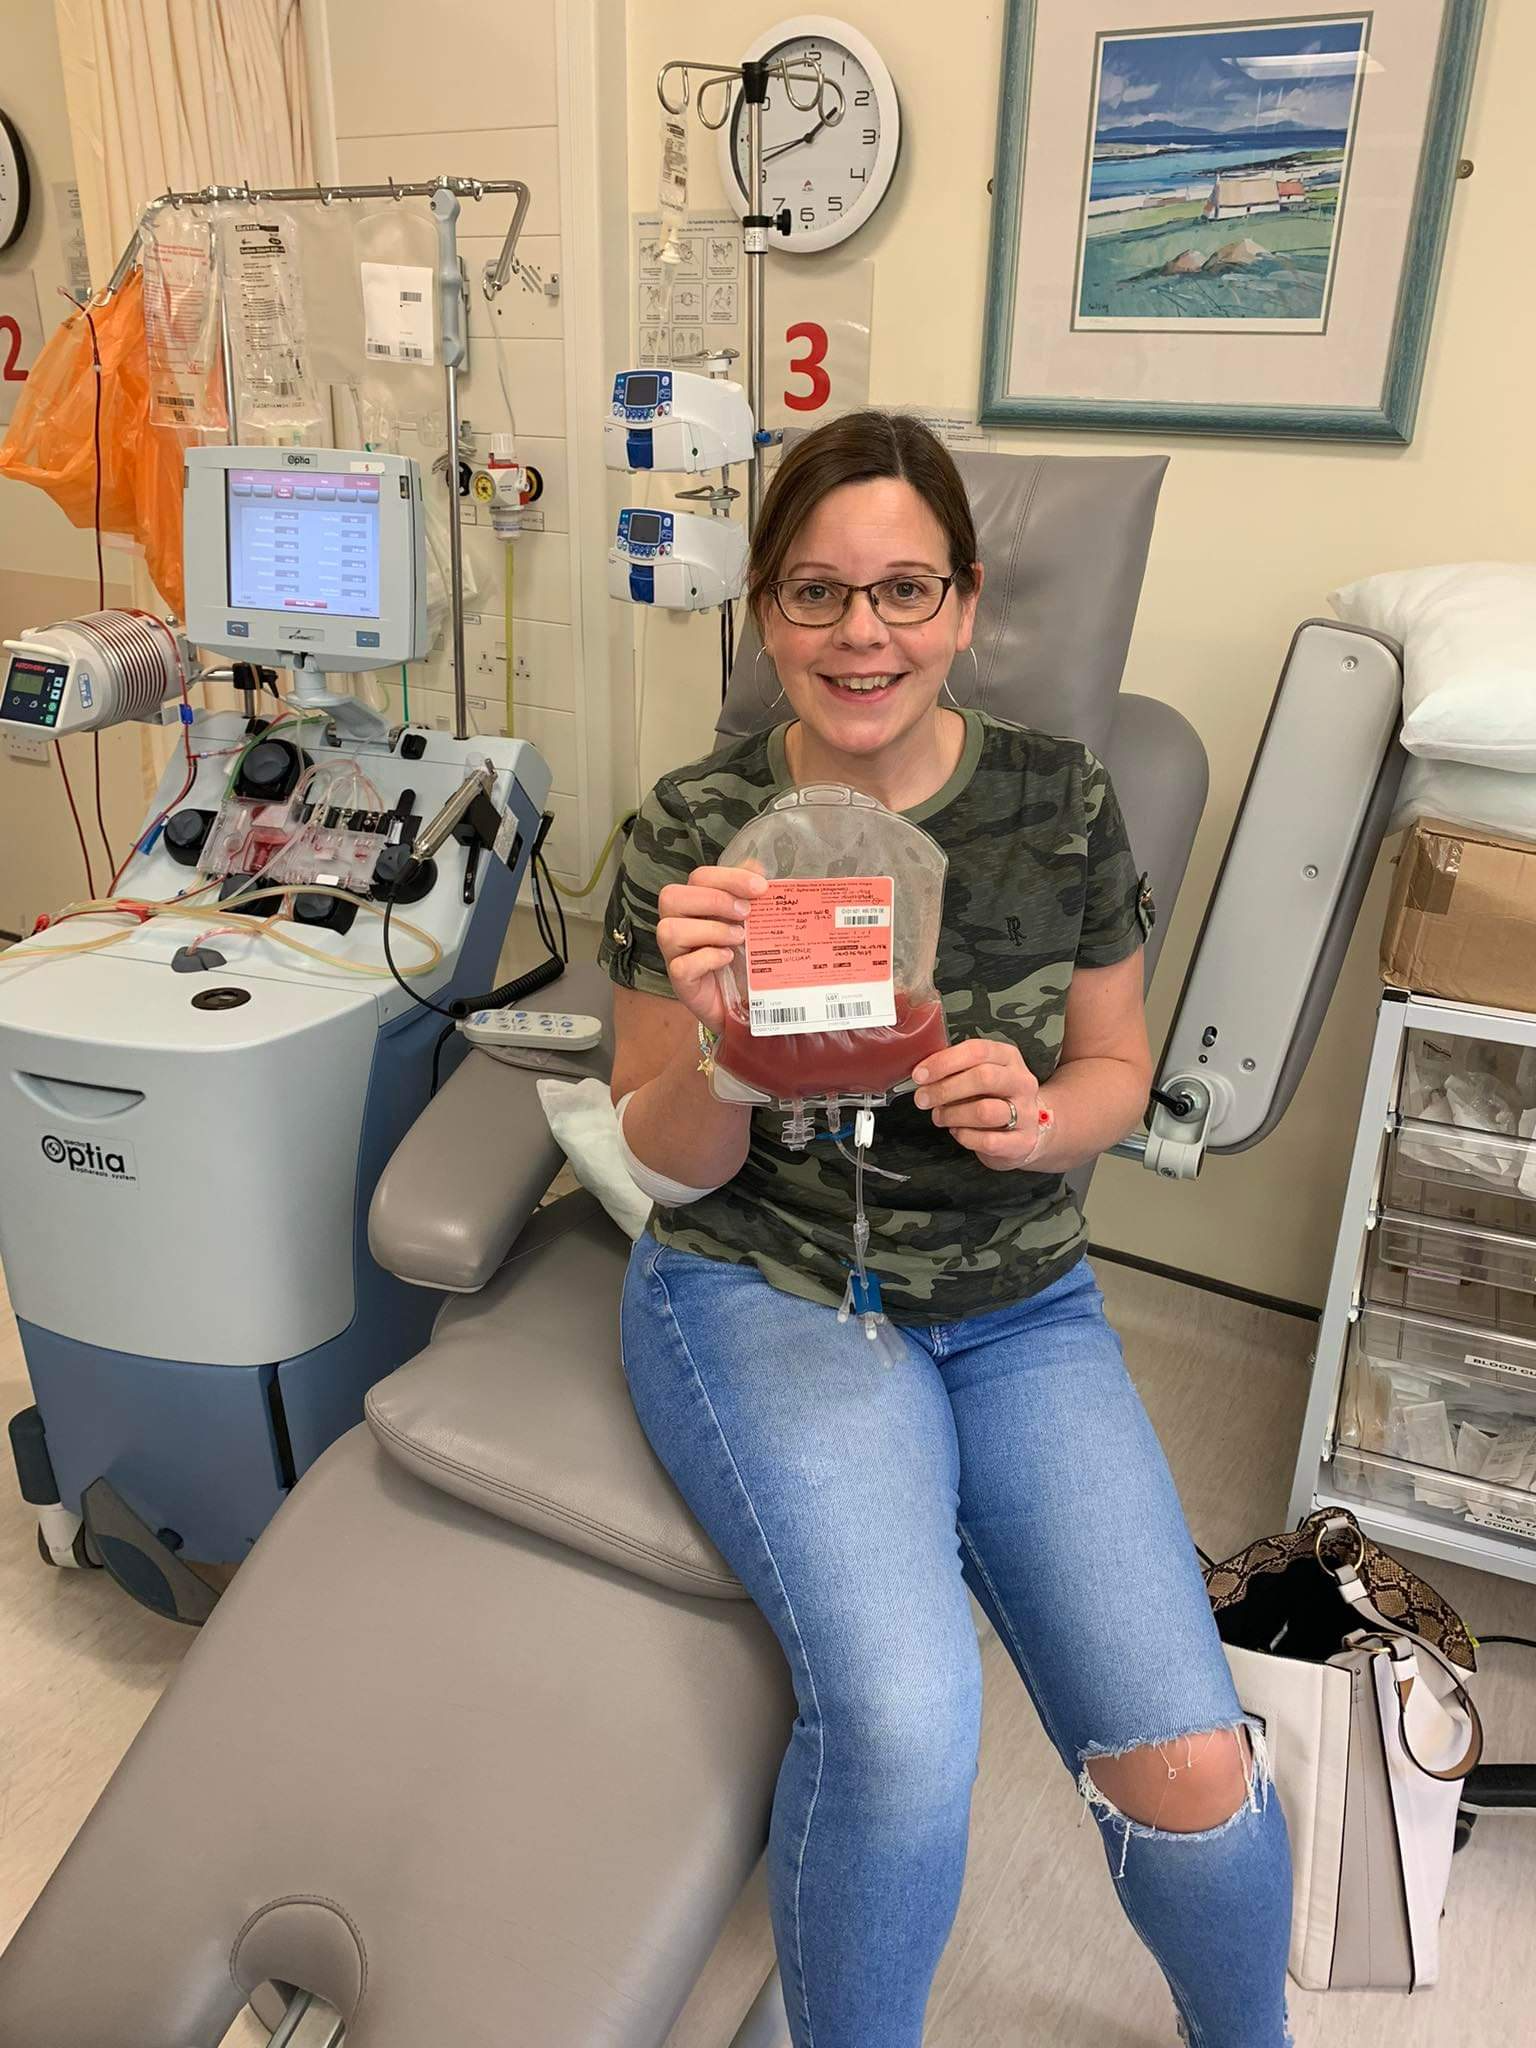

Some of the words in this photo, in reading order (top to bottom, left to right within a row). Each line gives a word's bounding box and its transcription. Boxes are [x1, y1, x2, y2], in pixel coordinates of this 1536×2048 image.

[855, 90, 870, 106] 2
[863, 129, 877, 144] 3
[850, 168, 866, 182] 4
[772, 197, 786, 212] 7
[828, 196, 843, 211] 5
[800, 207, 815, 222] 6
[0, 315, 29, 381] 2
[784, 322, 830, 411] 3
[41, 1134, 126, 1174] Optia
[1473, 1358, 1517, 1373] BLOOD
[1496, 1514, 1522, 1524] WAY
